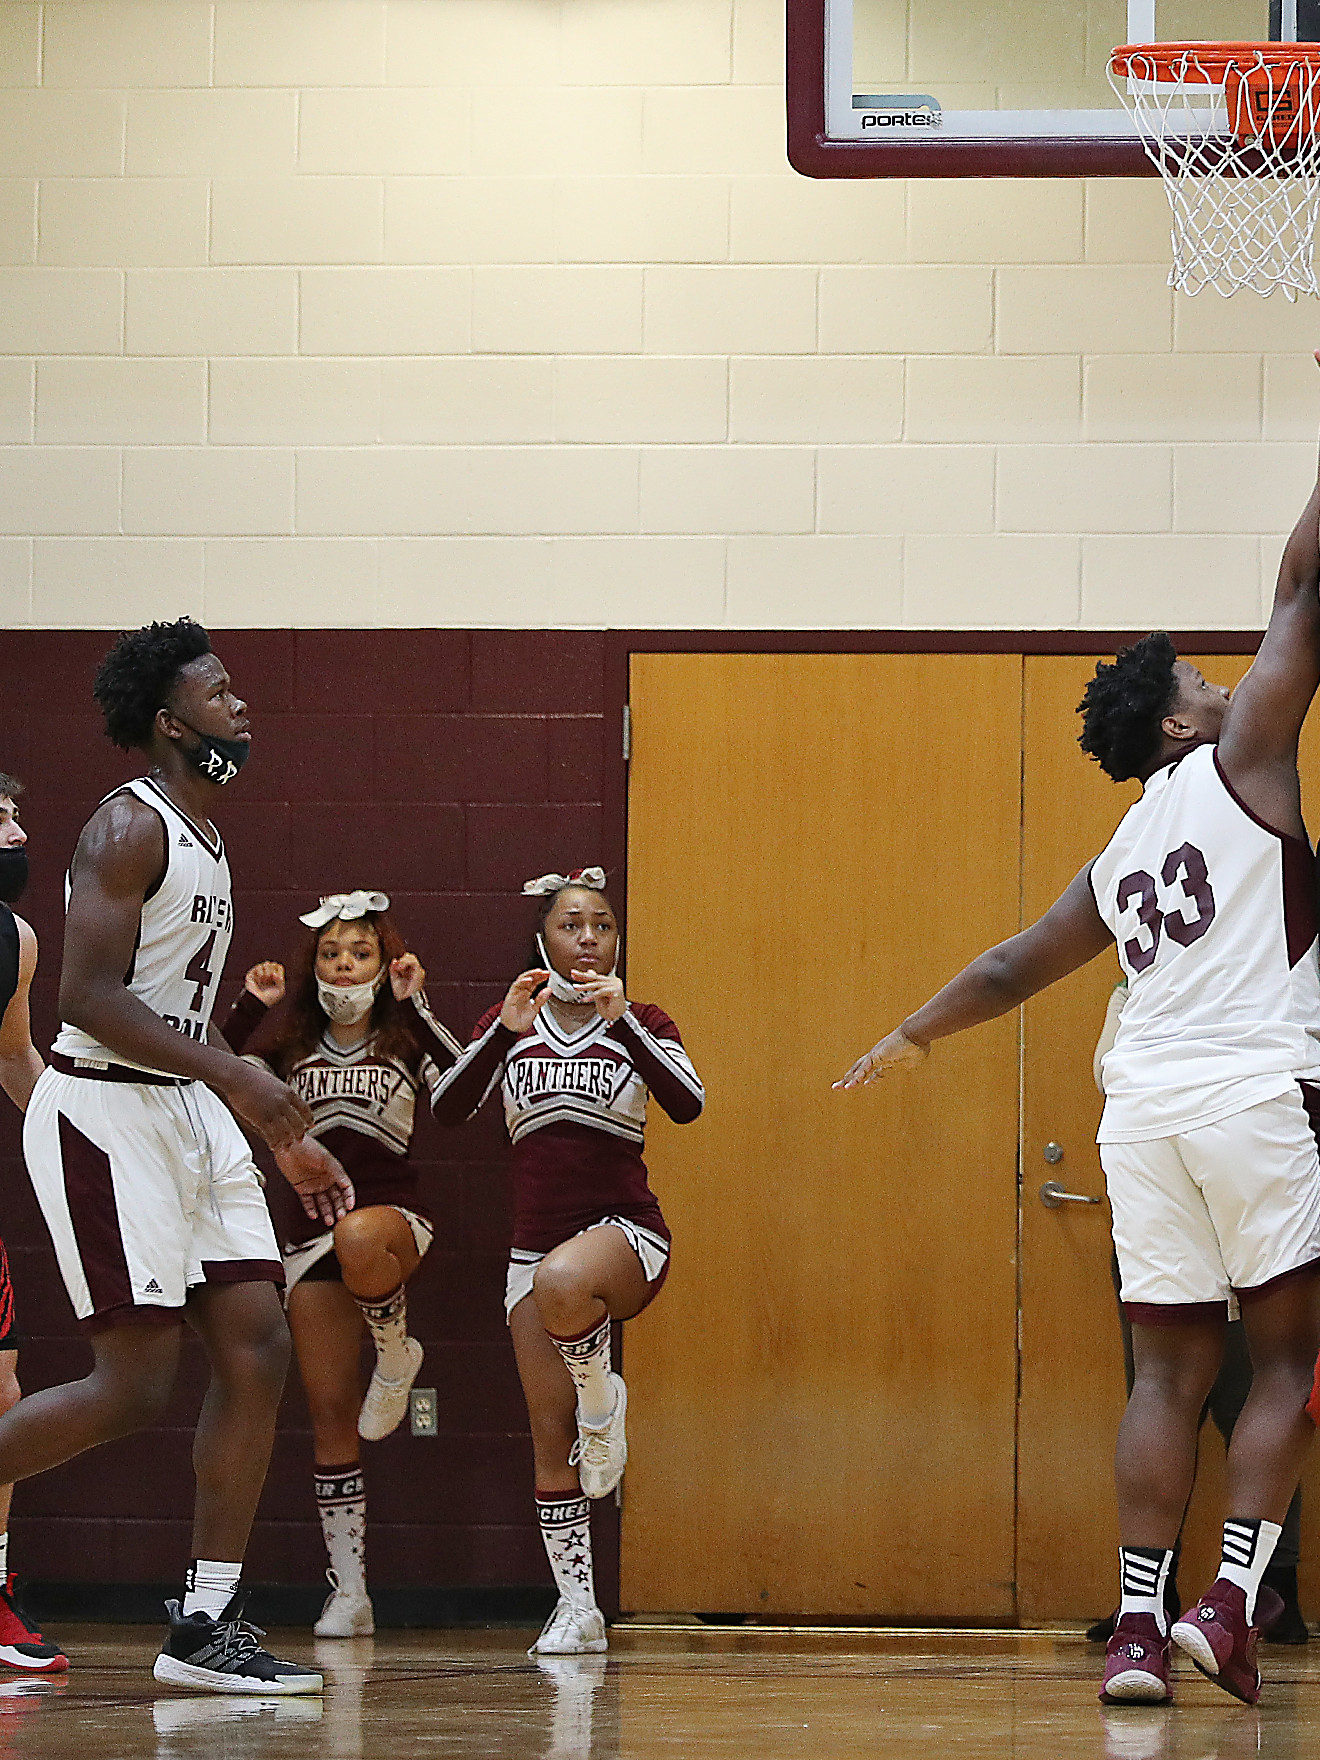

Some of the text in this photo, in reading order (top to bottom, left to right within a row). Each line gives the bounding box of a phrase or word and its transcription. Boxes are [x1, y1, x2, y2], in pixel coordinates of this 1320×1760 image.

[1116, 841, 1216, 974] 33
[184, 929, 217, 1013] 4
[298, 1068, 391, 1105] PANTHERS
[515, 1061, 614, 1101] PANTHERS
